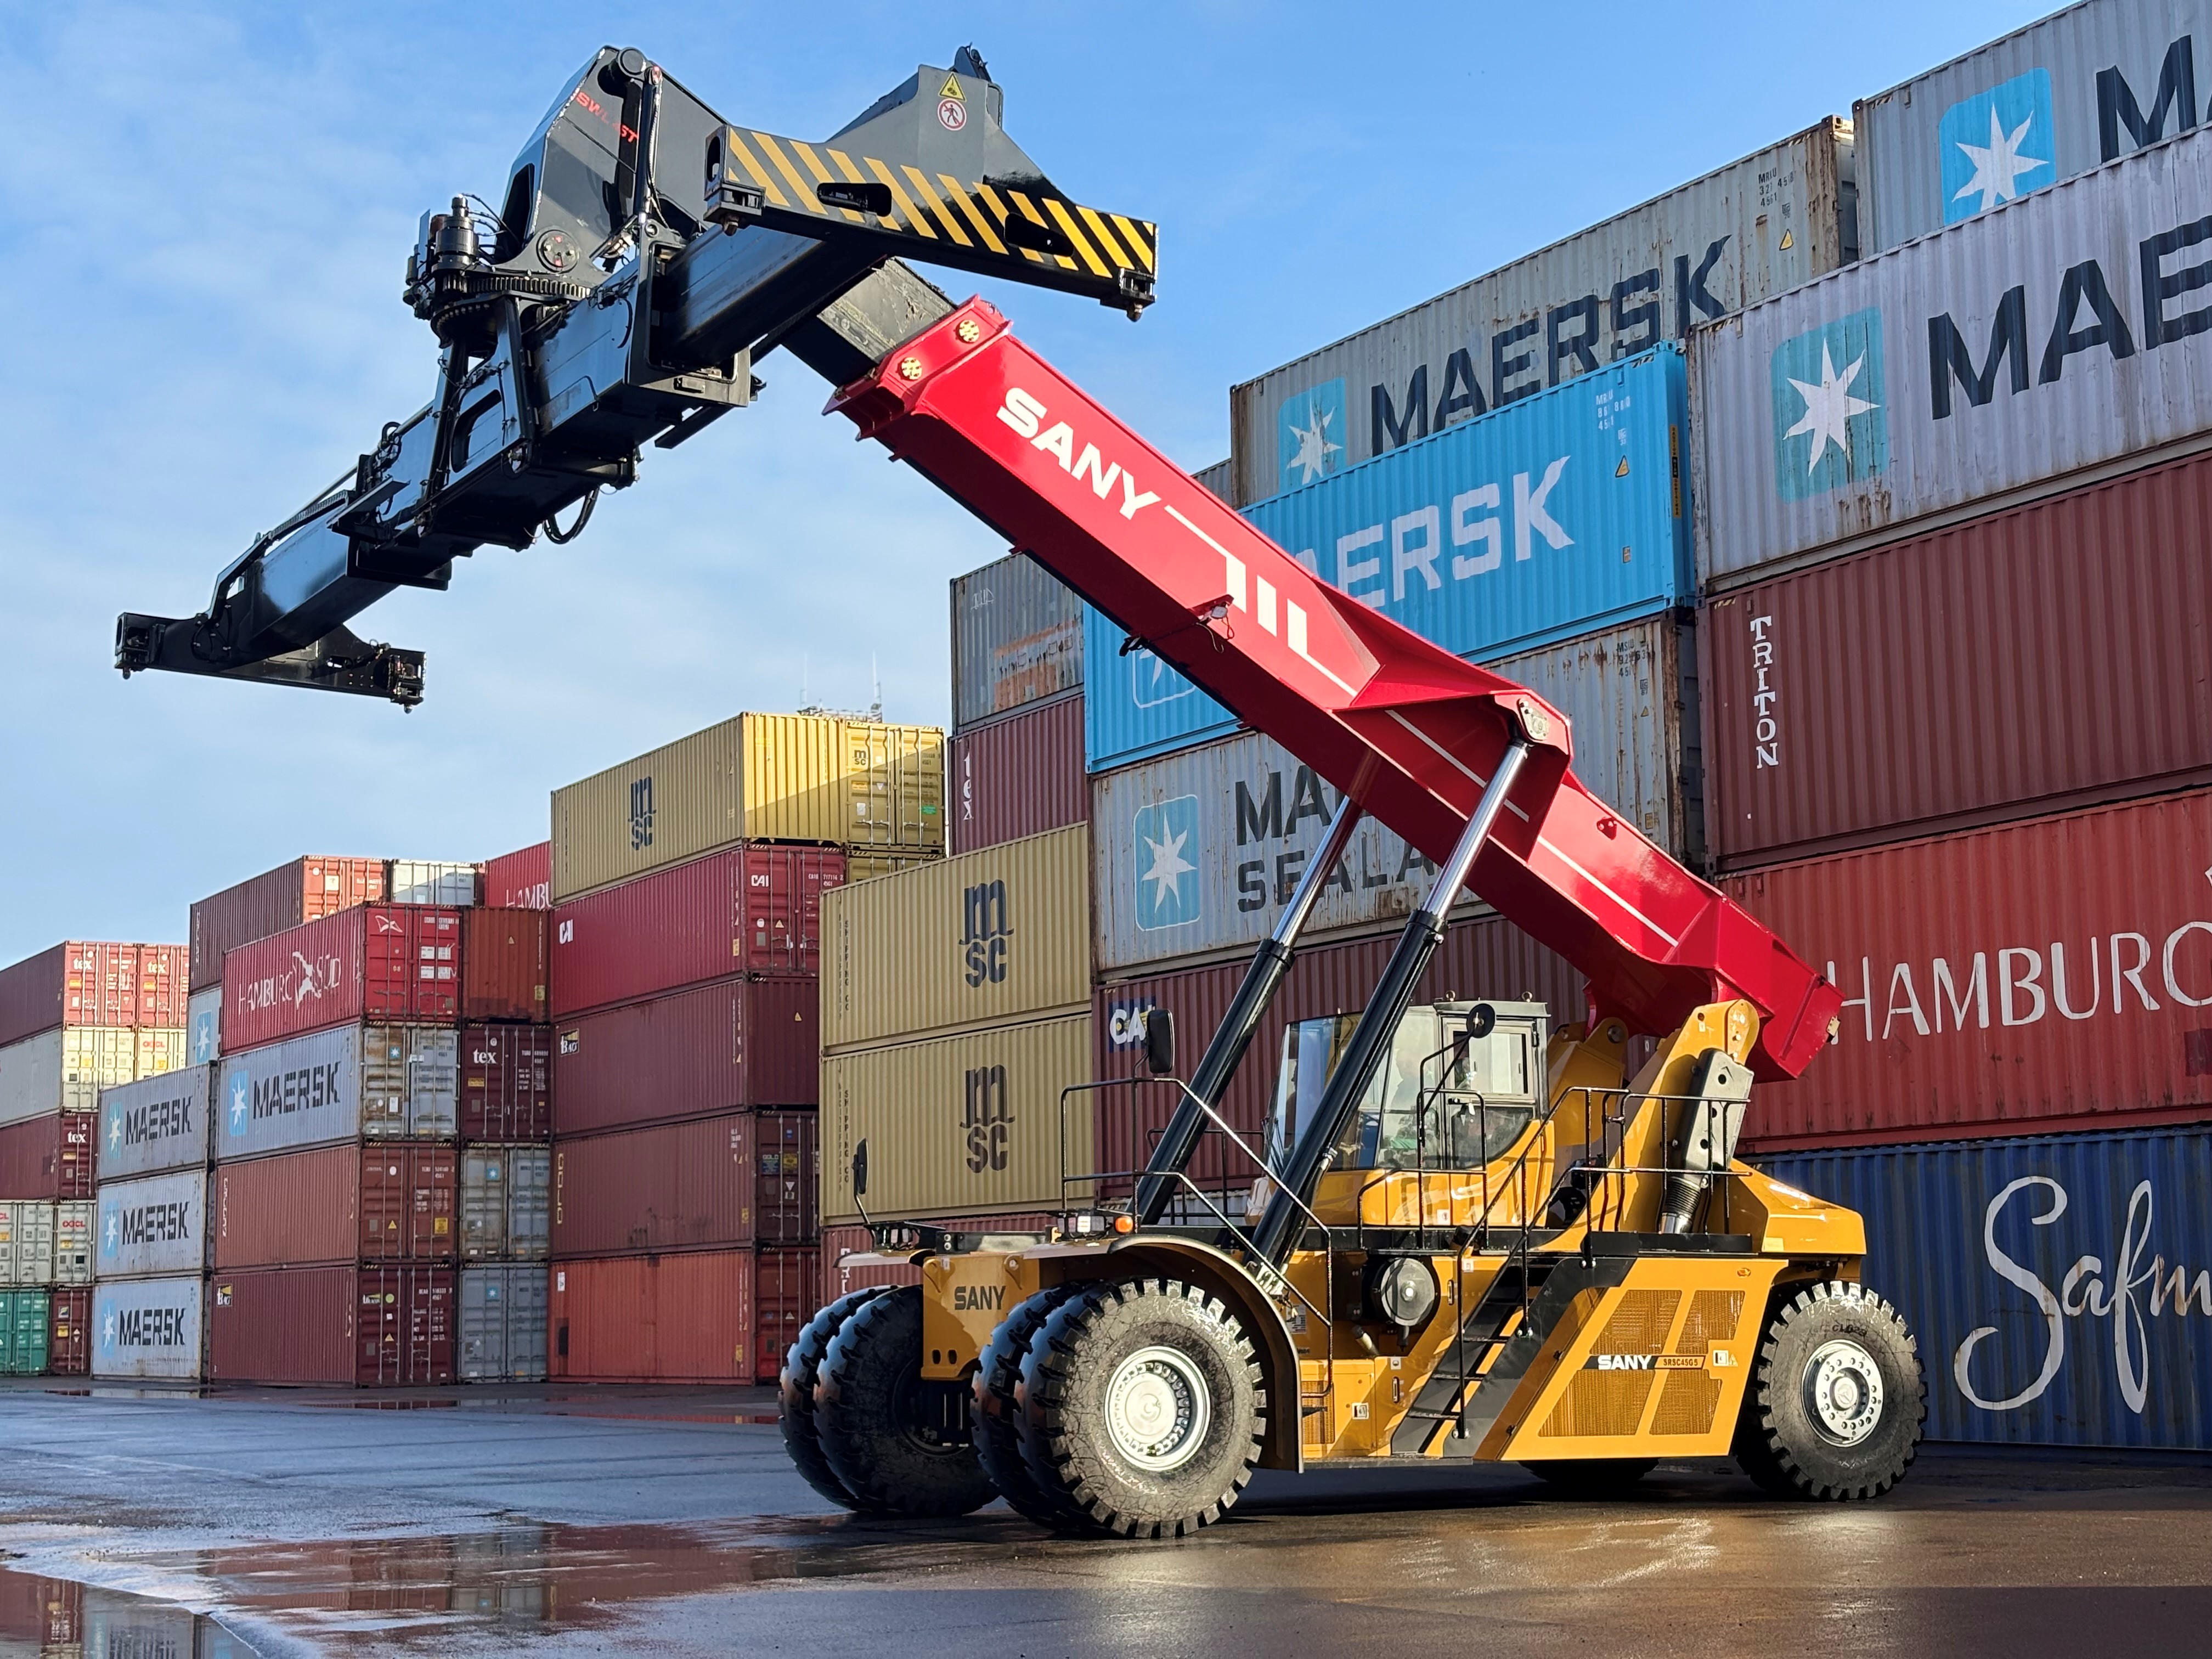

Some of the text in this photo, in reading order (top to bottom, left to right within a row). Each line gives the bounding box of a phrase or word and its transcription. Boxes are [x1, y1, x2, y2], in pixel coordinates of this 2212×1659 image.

[1371, 234, 1731, 456] MAERSK
[996, 387, 1162, 521] SANY
[1295, 455, 1575, 607] ERSK
[1750, 616, 1779, 769] TRITON
[963, 752, 974, 821] tex
[751, 874, 769, 887] CAI
[73, 957, 93, 970] tex
[147, 961, 166, 974] tex
[1110, 1006, 1156, 1045] CA
[473, 1048, 497, 1064] tex
[253, 1060, 342, 1120] MAERSK
[67, 1130, 87, 1143] tex
[126, 1096, 193, 1146] MAERSK
[122, 1201, 190, 1245] MAERSK
[954, 1285, 1006, 1311] SANY
[119, 1308, 186, 1346] MAERSK
[1597, 1354, 1652, 1370] SANY
